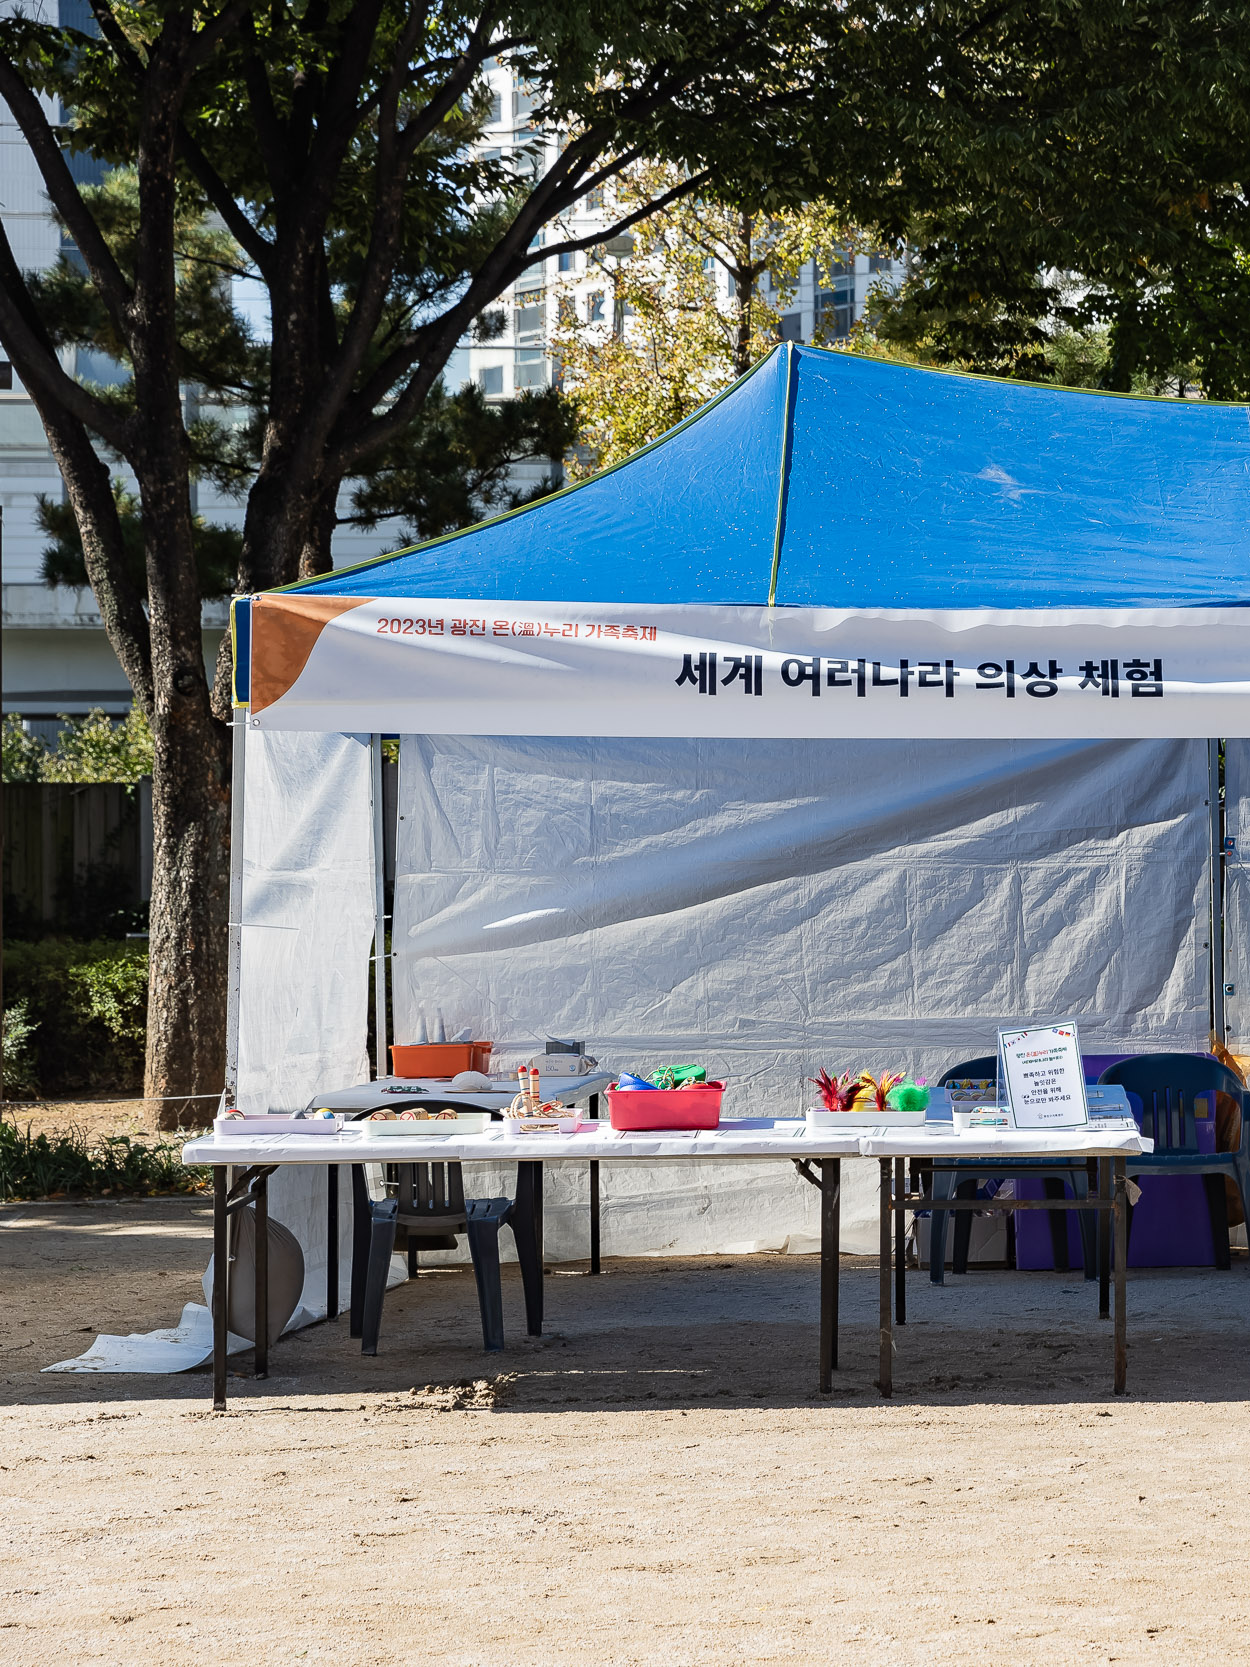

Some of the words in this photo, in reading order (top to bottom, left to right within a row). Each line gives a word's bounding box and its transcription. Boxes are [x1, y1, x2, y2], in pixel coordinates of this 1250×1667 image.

[376, 617, 445, 636] 2023년
[450, 618, 486, 637] 광진
[491, 619, 579, 639] 온(溫)누리
[584, 623, 658, 642] 가족축제
[675, 651, 764, 698] 세계
[780, 655, 960, 699] 여러나라
[975, 658, 1063, 699] 의상
[1078, 657, 1165, 699] 체험
[1047, 1068, 1065, 1076] 위험한
[1024, 1097, 1047, 1105] 눈으로만
